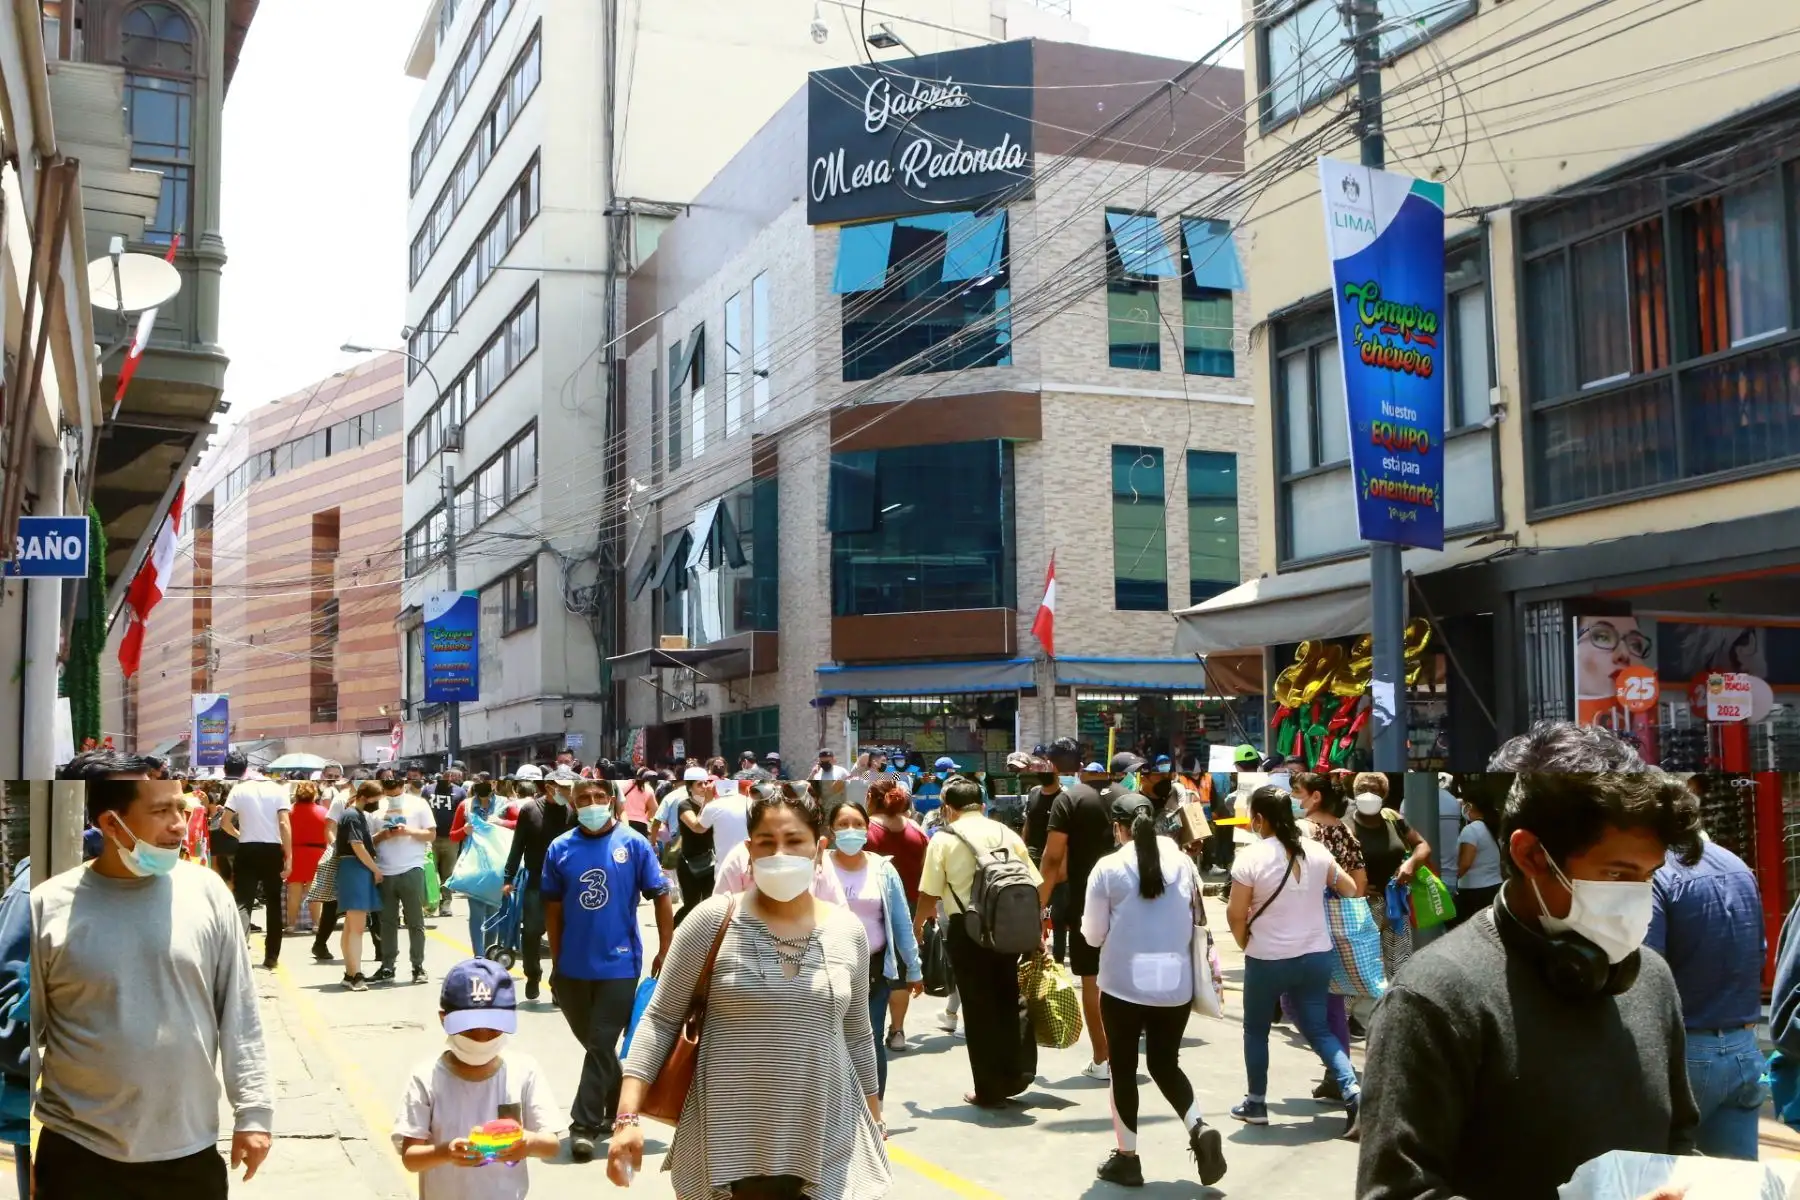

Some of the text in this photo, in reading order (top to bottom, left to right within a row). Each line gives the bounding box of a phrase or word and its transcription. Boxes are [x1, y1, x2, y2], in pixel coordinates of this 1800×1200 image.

[864, 76, 969, 133] Galería
[811, 132, 1027, 202] Mesa Redonda
[1334, 211, 1376, 235] LIMA
[1344, 279, 1438, 340] Compra
[1360, 333, 1433, 379] chévere
[1381, 400, 1417, 422] Nuestro
[1371, 420, 1429, 455] EQUIPO
[1382, 455, 1420, 477] está para
[1626, 676, 1656, 700] 25
[1717, 704, 1741, 717] 2022
[579, 868, 609, 910] 3
[470, 976, 492, 1002] LA
